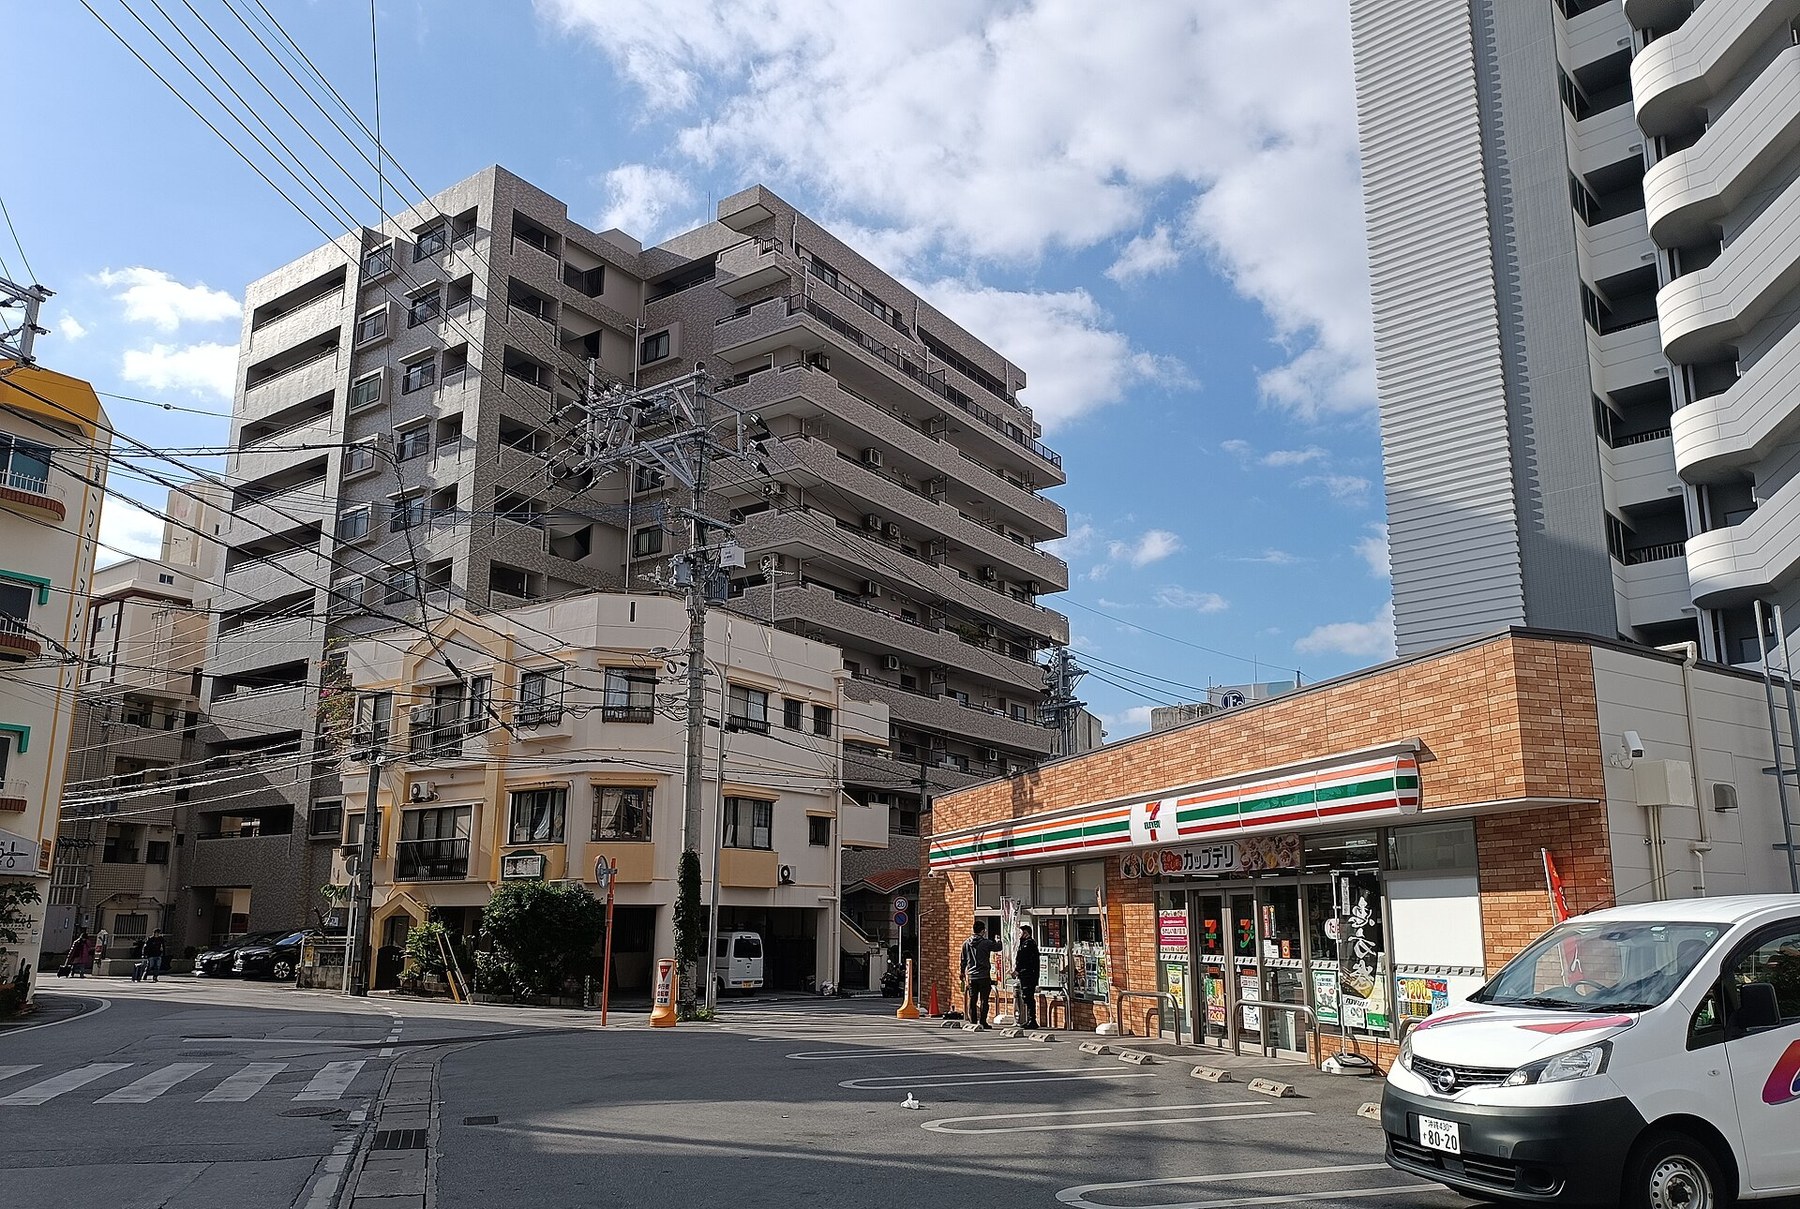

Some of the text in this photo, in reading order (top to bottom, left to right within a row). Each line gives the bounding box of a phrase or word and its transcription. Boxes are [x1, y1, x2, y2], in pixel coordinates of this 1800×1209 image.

[1184, 845, 1234, 871] カップデリ
[896, 900, 905, 908] 20
[1428, 1130, 1457, 1150] 80-20
